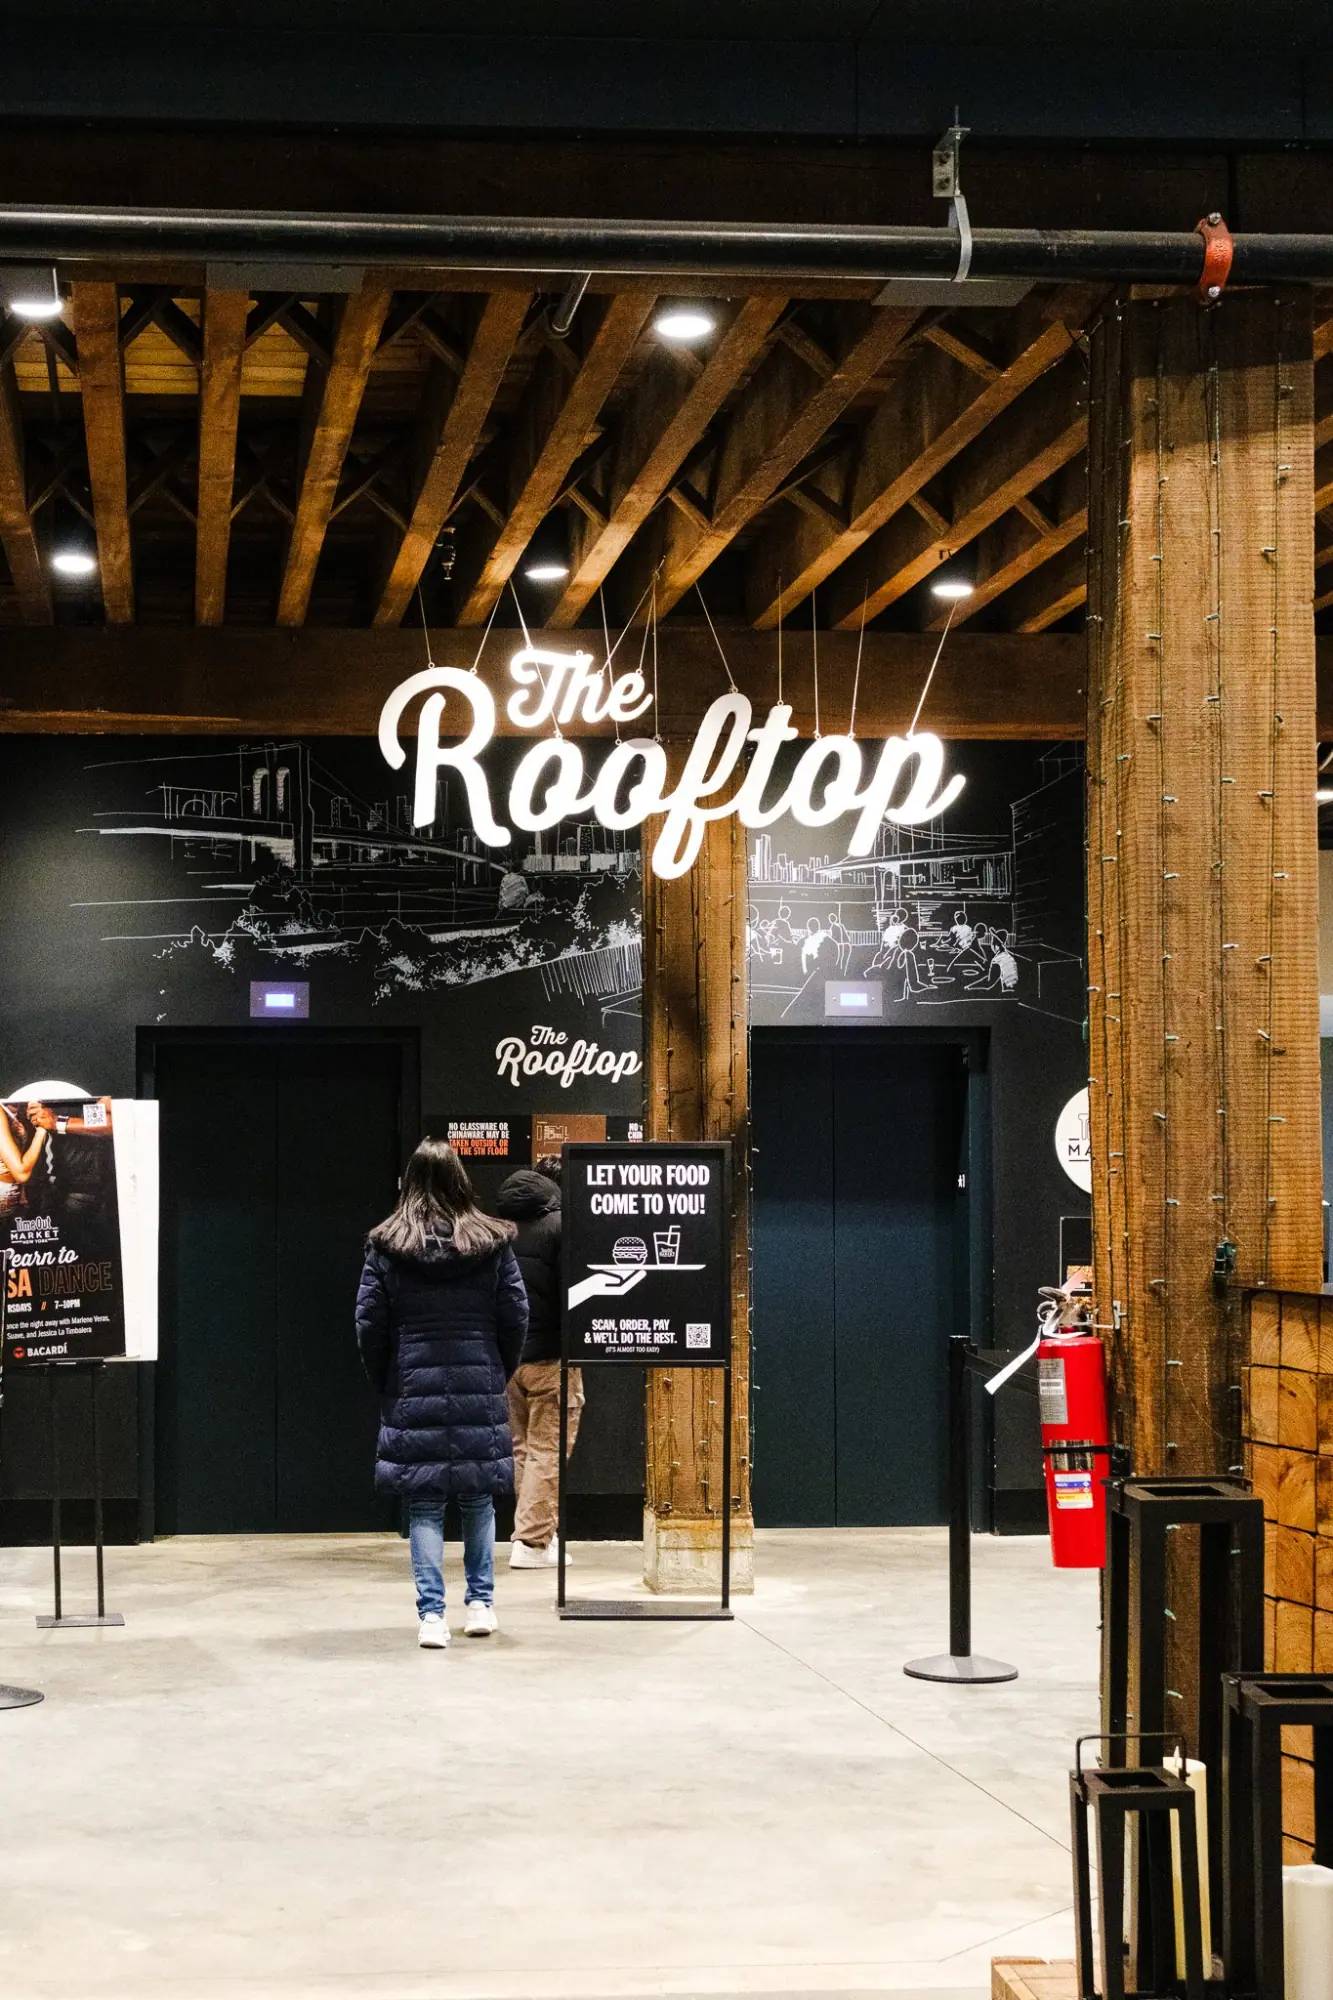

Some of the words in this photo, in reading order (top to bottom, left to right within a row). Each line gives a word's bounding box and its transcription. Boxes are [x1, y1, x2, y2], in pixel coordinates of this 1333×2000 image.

[507, 648, 654, 728] The
[378, 667, 966, 879] Rooftop
[531, 1025, 568, 1046] The
[495, 1037, 643, 1088] Rooftop
[448, 1122, 458, 1131] NO
[460, 1122, 498, 1131] GLASSWARE
[499, 1122, 509, 1131] OR
[447, 1130, 485, 1139] CHINAWARE
[486, 1130, 499, 1139] MAY
[501, 1130, 510, 1139] BE
[449, 1139, 469, 1147] TAKEN
[470, 1139, 498, 1147] OUTSIDE
[499, 1139, 509, 1147] OR
[460, 1147, 472, 1155] THE
[487, 1147, 509, 1155] FLOOR
[587, 1164, 615, 1186] LET
[618, 1164, 662, 1186] YOUR
[666, 1164, 710, 1186] FOOD
[590, 1193, 642, 1215] COME
[644, 1193, 664, 1215] TO
[667, 1193, 705, 1215] YOU!
[36, 1216, 52, 1230] Out
[10, 1230, 59, 1240] MARKET
[58, 1246, 78, 1264] to
[39, 1261, 113, 1296] DANCE
[20, 1321, 30, 1329] the
[30, 1320, 44, 1329] night
[45, 1319, 58, 1327] away
[592, 1319, 618, 1332] SCAN,
[620, 1319, 651, 1332] ORDER,
[653, 1319, 670, 1330] PAY
[38, 1329, 57, 1338] Jessica
[58, 1328, 65, 1336] La
[584, 1332, 592, 1344] &
[620, 1332, 634, 1344] DO
[634, 1332, 652, 1344] THE
[653, 1332, 678, 1344] REST.
[27, 1342, 68, 1357] BACARDÍ
[617, 1346, 635, 1354] ALMOST
[636, 1346, 645, 1354] TOO
[646, 1346, 660, 1354] EASY)
